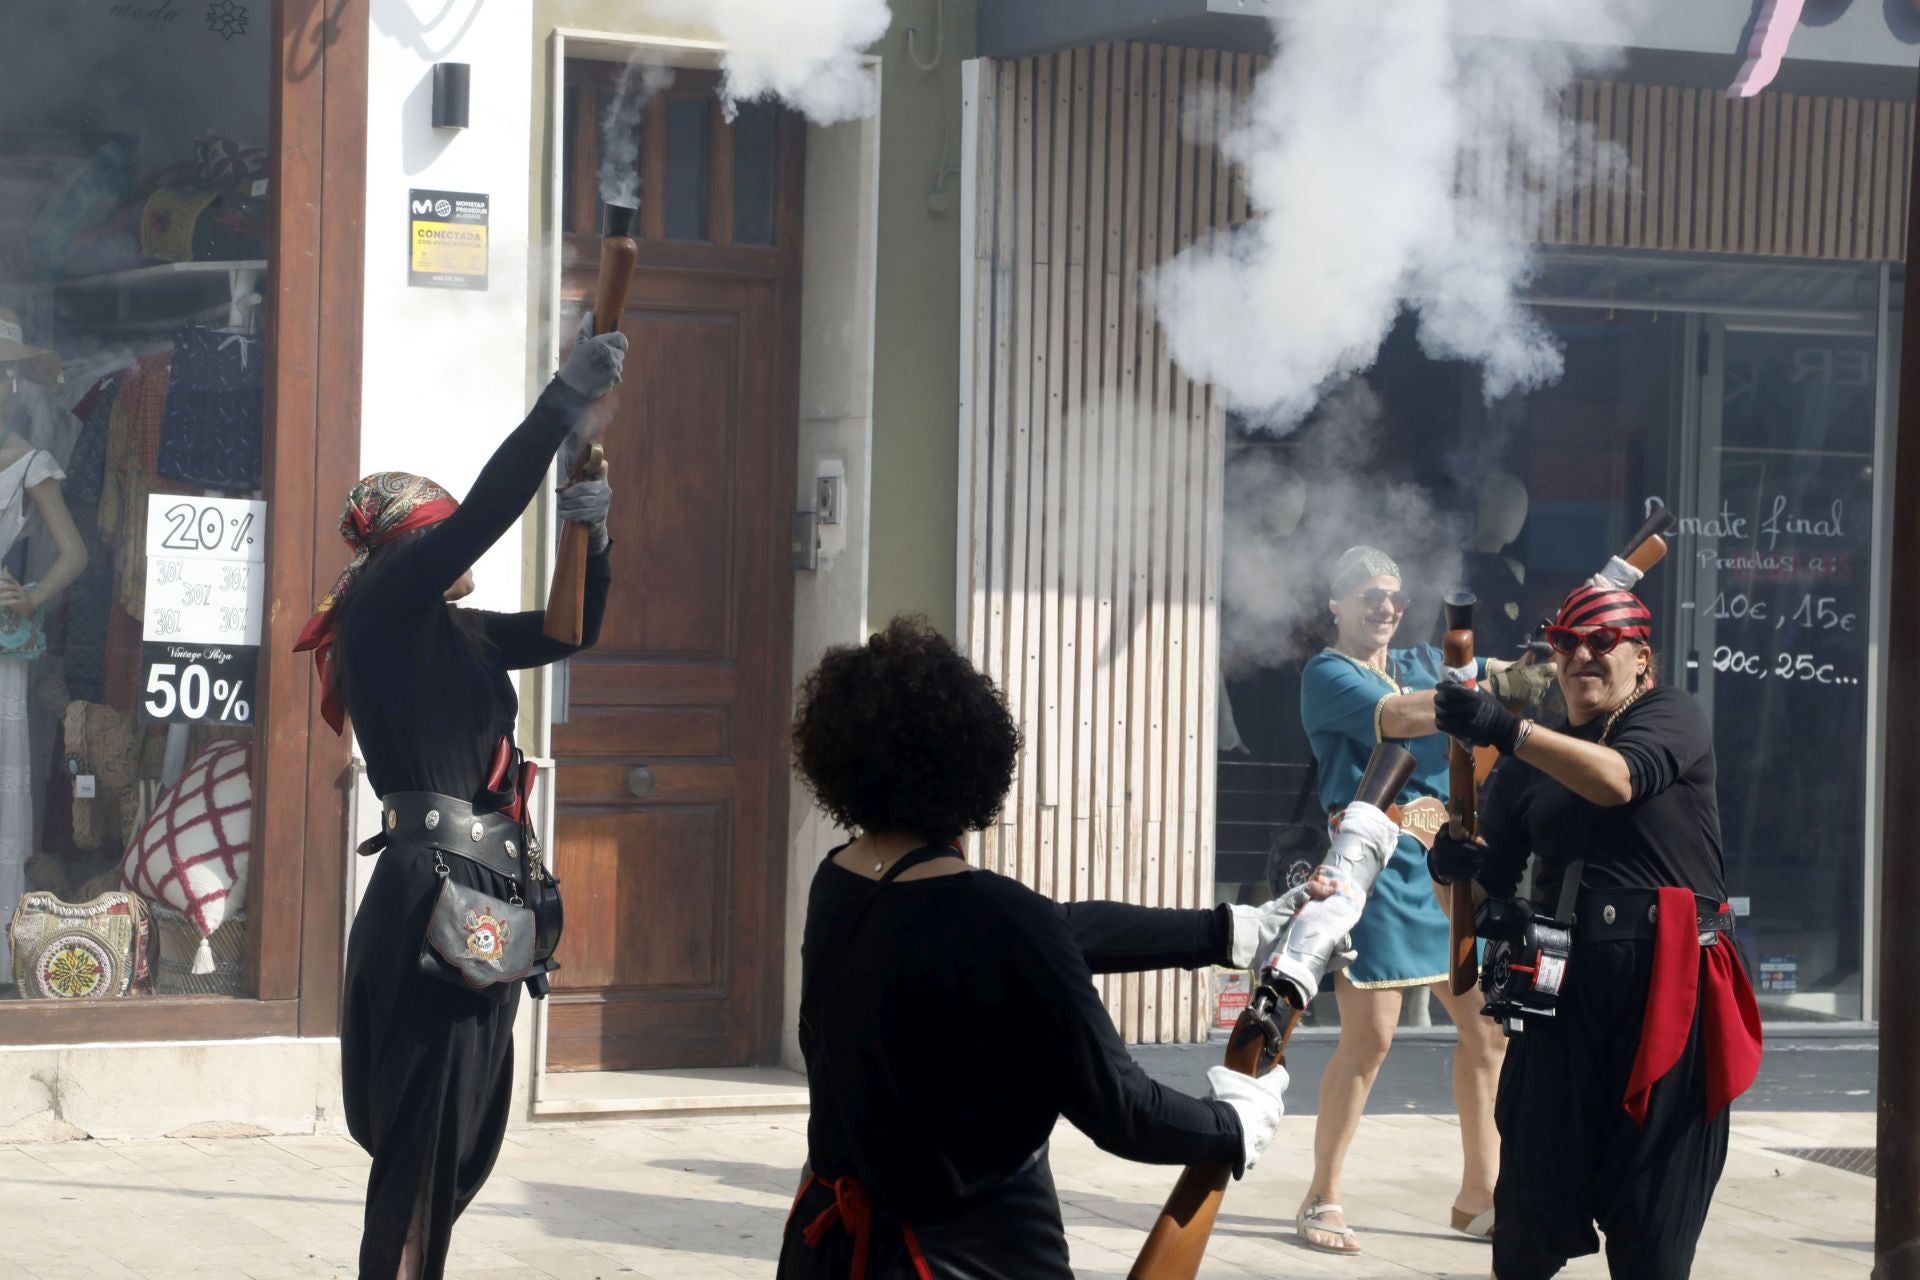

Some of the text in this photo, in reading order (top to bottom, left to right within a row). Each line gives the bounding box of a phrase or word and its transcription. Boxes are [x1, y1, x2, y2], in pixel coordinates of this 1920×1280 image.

[455, 200, 485, 208] MOVISTAR
[417, 229, 482, 242] CONECTADA
[161, 503, 254, 552] 20%
[1762, 495, 1844, 551] final
[156, 559, 184, 585] 30%
[1697, 549, 1793, 572] Prendas
[219, 565, 250, 592] 30%
[181, 582, 212, 607] 30%
[154, 608, 182, 636] 30%
[219, 606, 249, 633] 30%
[167, 646, 203, 663] Vintage
[145, 663, 250, 721] 50%
